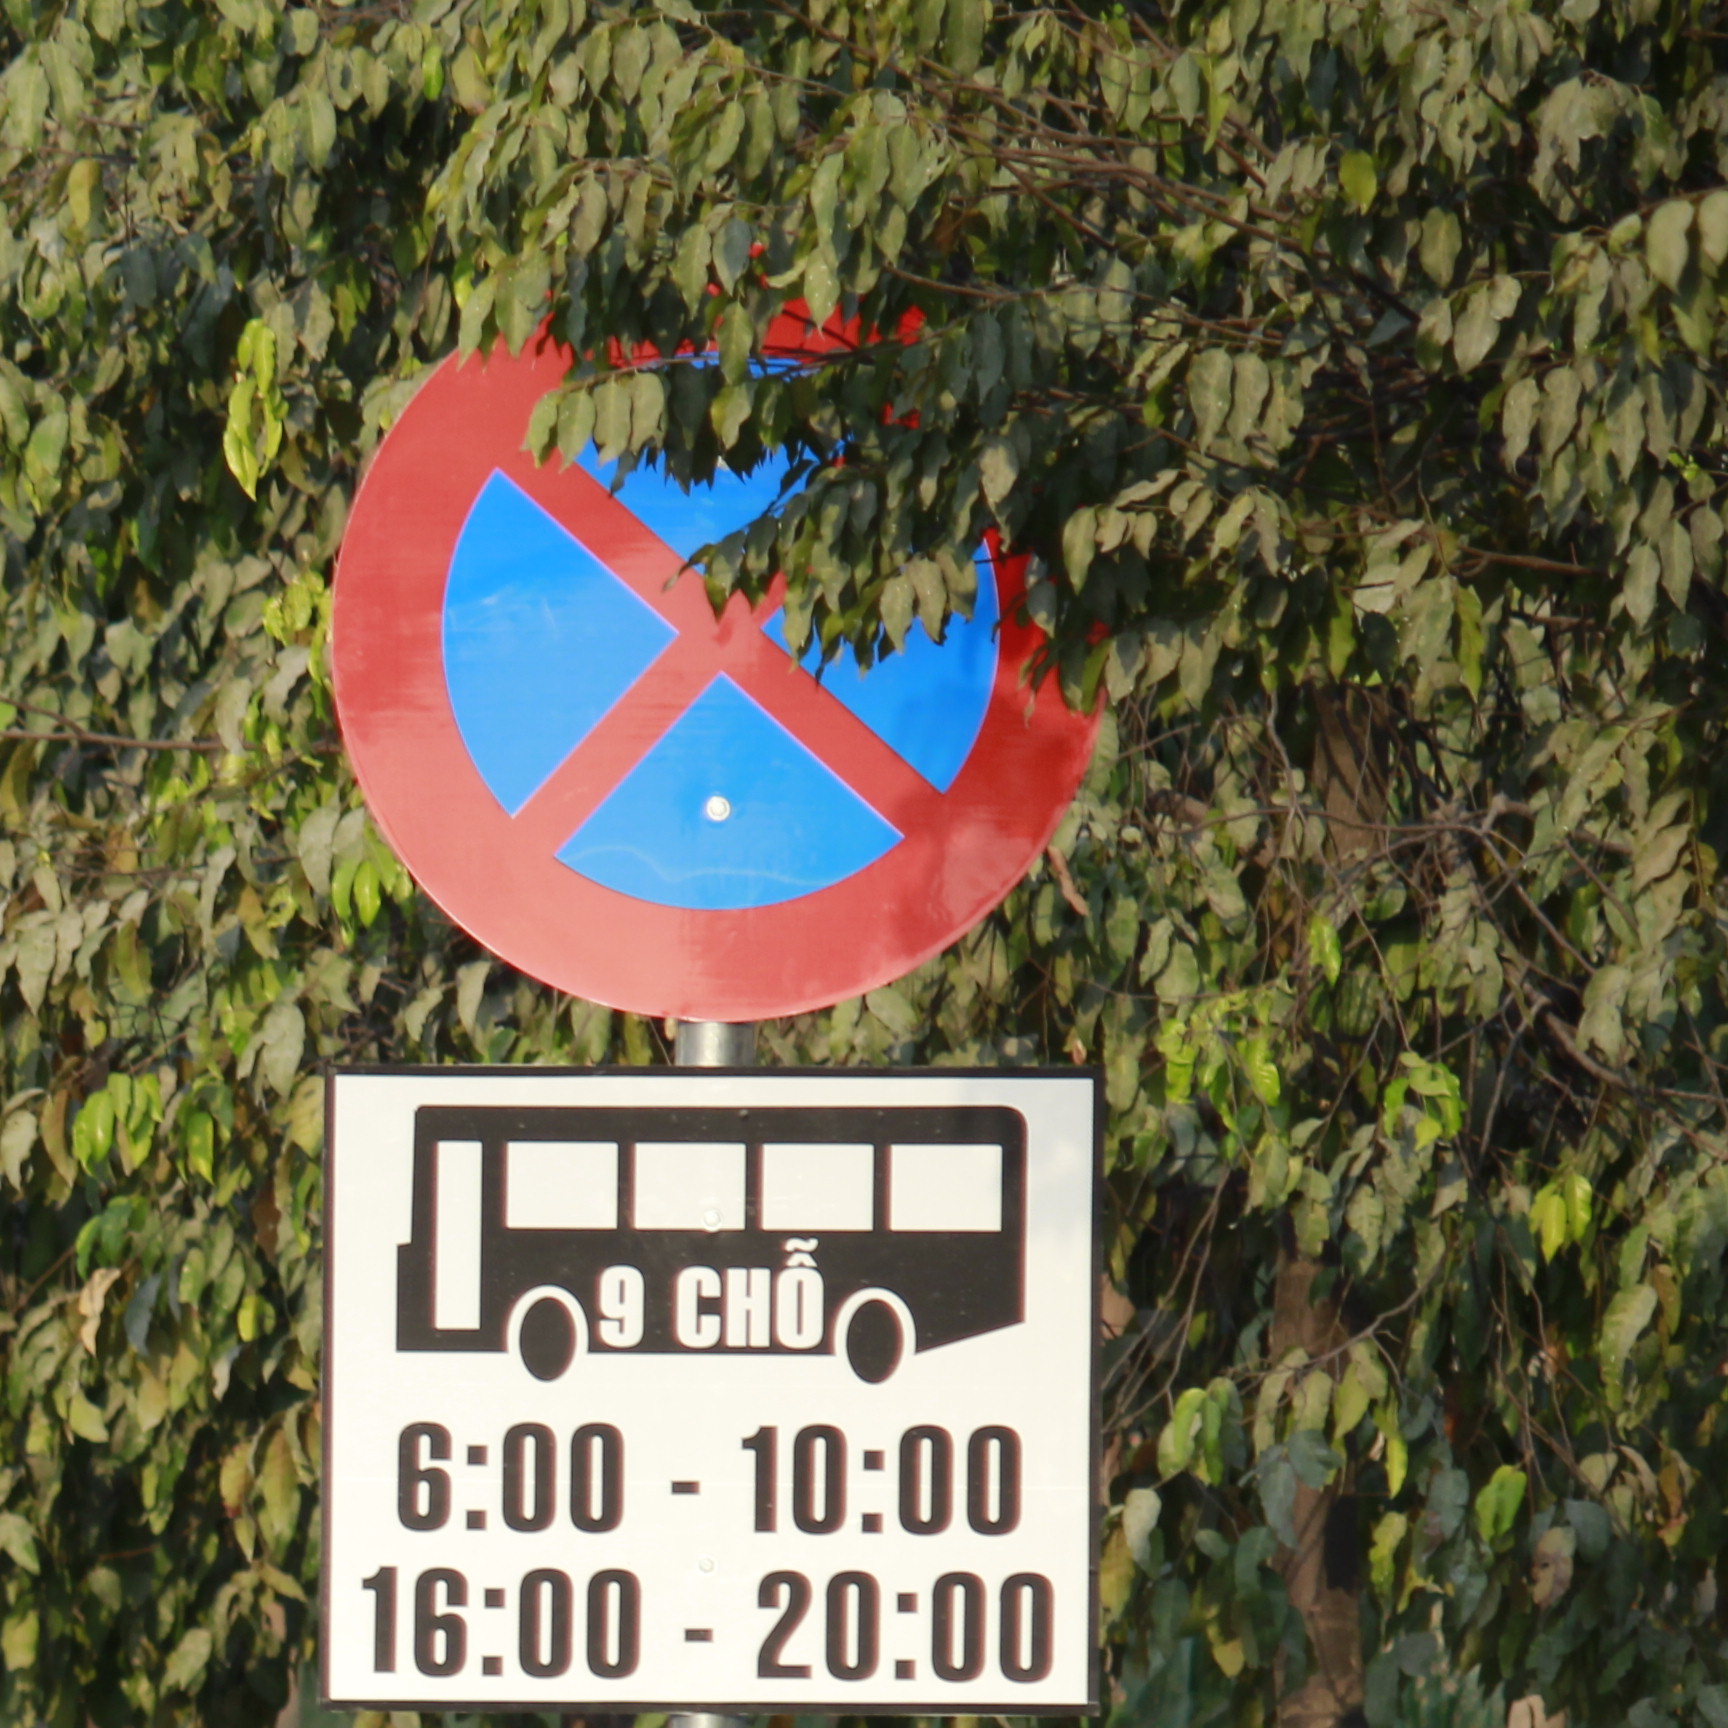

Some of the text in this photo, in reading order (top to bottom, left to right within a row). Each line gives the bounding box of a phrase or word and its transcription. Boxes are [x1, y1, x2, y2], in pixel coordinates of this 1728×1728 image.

[599, 1237, 825, 1349] 9 CHỖ
[397, 1421, 625, 1534] 6:00
[742, 1424, 1022, 1536] 10:00
[362, 1565, 641, 1678] 16:00
[756, 1569, 1055, 1682] 20:00
